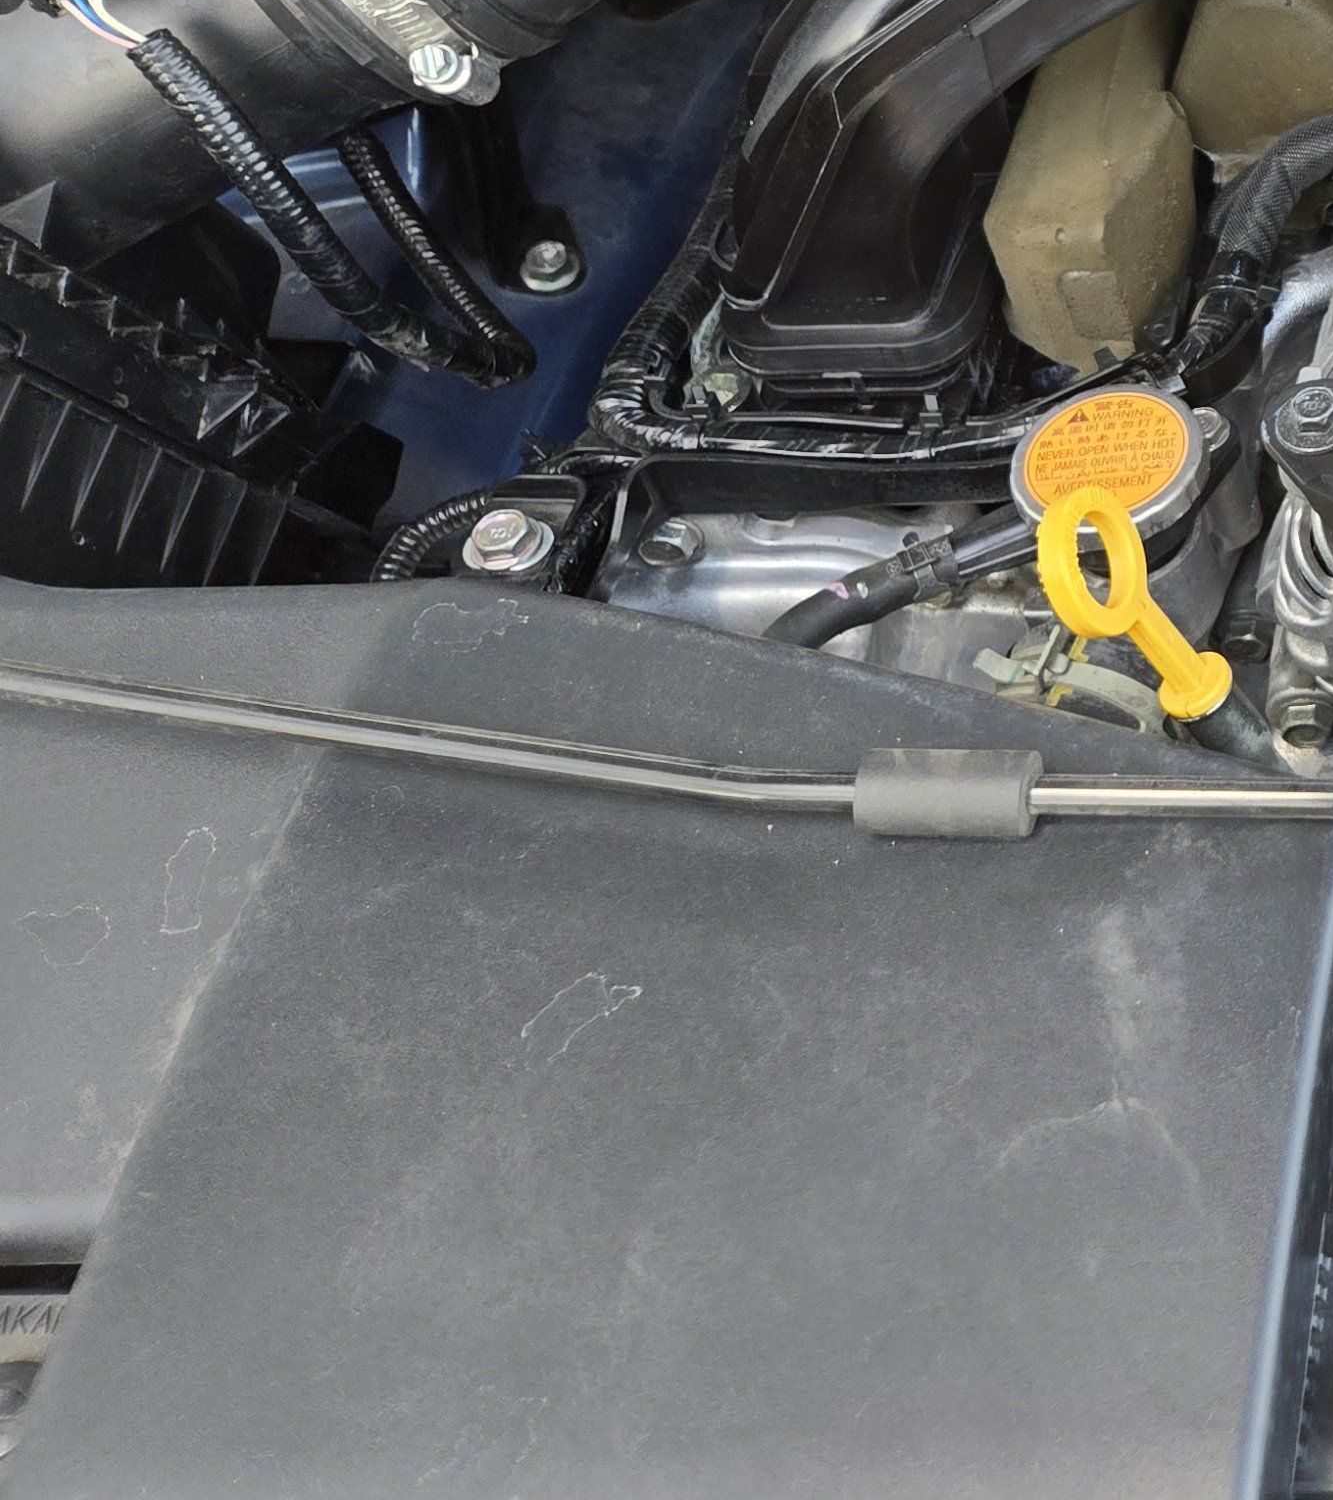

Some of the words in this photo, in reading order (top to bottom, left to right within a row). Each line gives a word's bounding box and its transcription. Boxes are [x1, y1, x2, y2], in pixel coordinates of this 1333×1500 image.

[1092, 407, 1154, 421] WARNING
[1036, 447, 1074, 462] NEVER
[1078, 444, 1111, 457] OPEN
[1113, 440, 1149, 452] WHEN
[1036, 462, 1049, 474] NE
[1051, 458, 1087, 473] JAMAIS
[1090, 454, 1127, 467] OUVRIR
